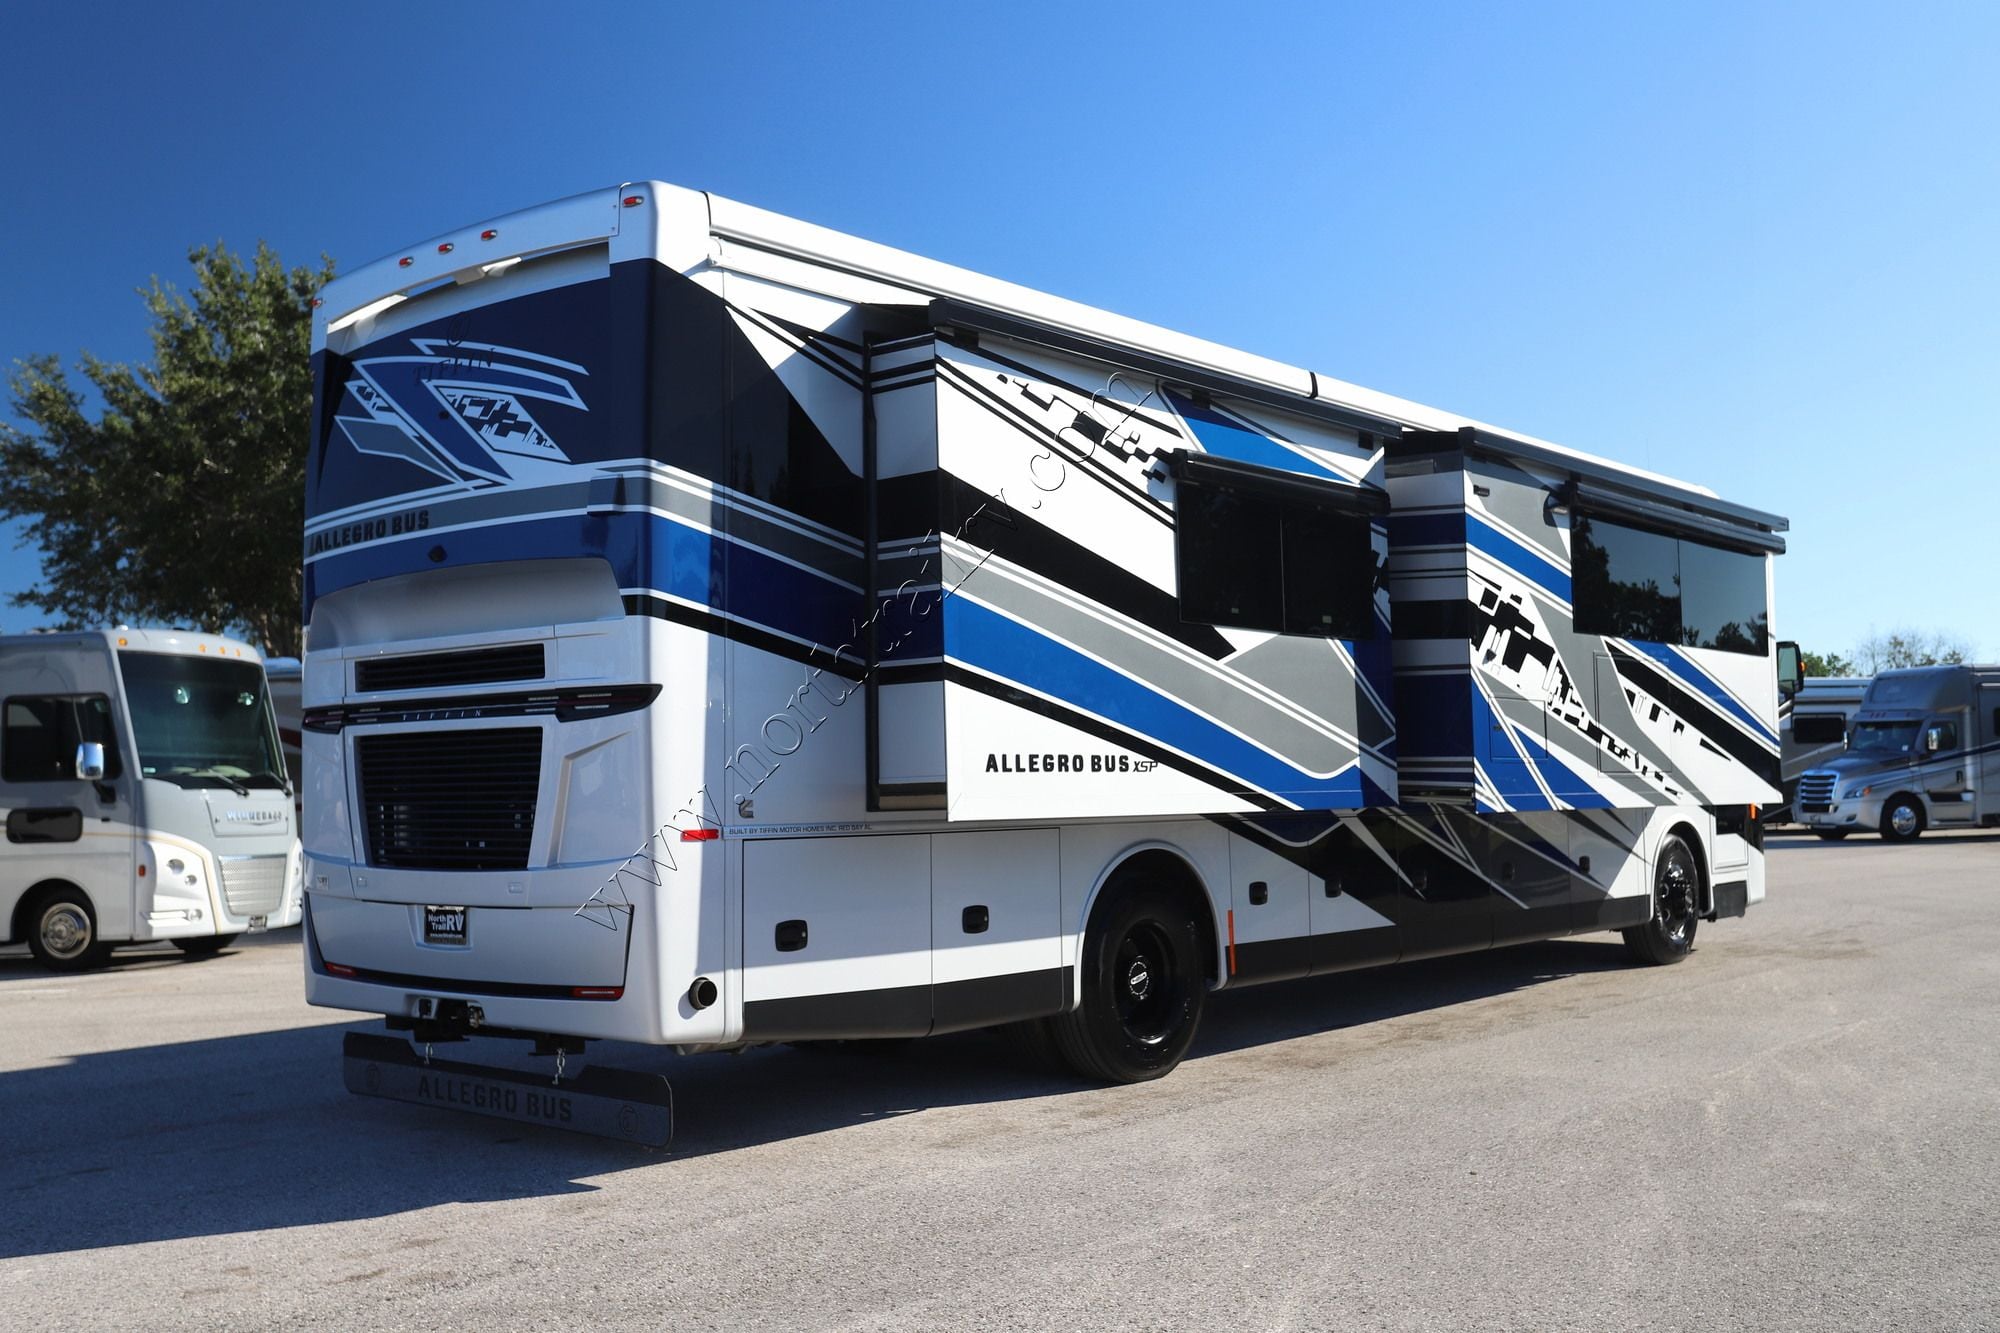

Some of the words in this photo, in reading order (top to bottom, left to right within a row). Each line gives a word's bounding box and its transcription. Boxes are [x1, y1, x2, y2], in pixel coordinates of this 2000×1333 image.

[314, 518, 387, 554] ALLEGRO
[391, 509, 430, 536] BUS
[985, 753, 1084, 773] ALLEGRO
[1090, 754, 1130, 773] BUS
[1132, 760, 1159, 773] XSP
[729, 827, 748, 835] BUILT
[749, 827, 758, 835] BY
[759, 826, 778, 834] TIFFIN
[802, 825, 825, 833] HOMES
[428, 914, 446, 923] North
[446, 913, 465, 932] RV
[431, 922, 446, 931] Trail
[418, 1074, 518, 1113] ALLEGRO
[526, 1091, 572, 1122] BUS
